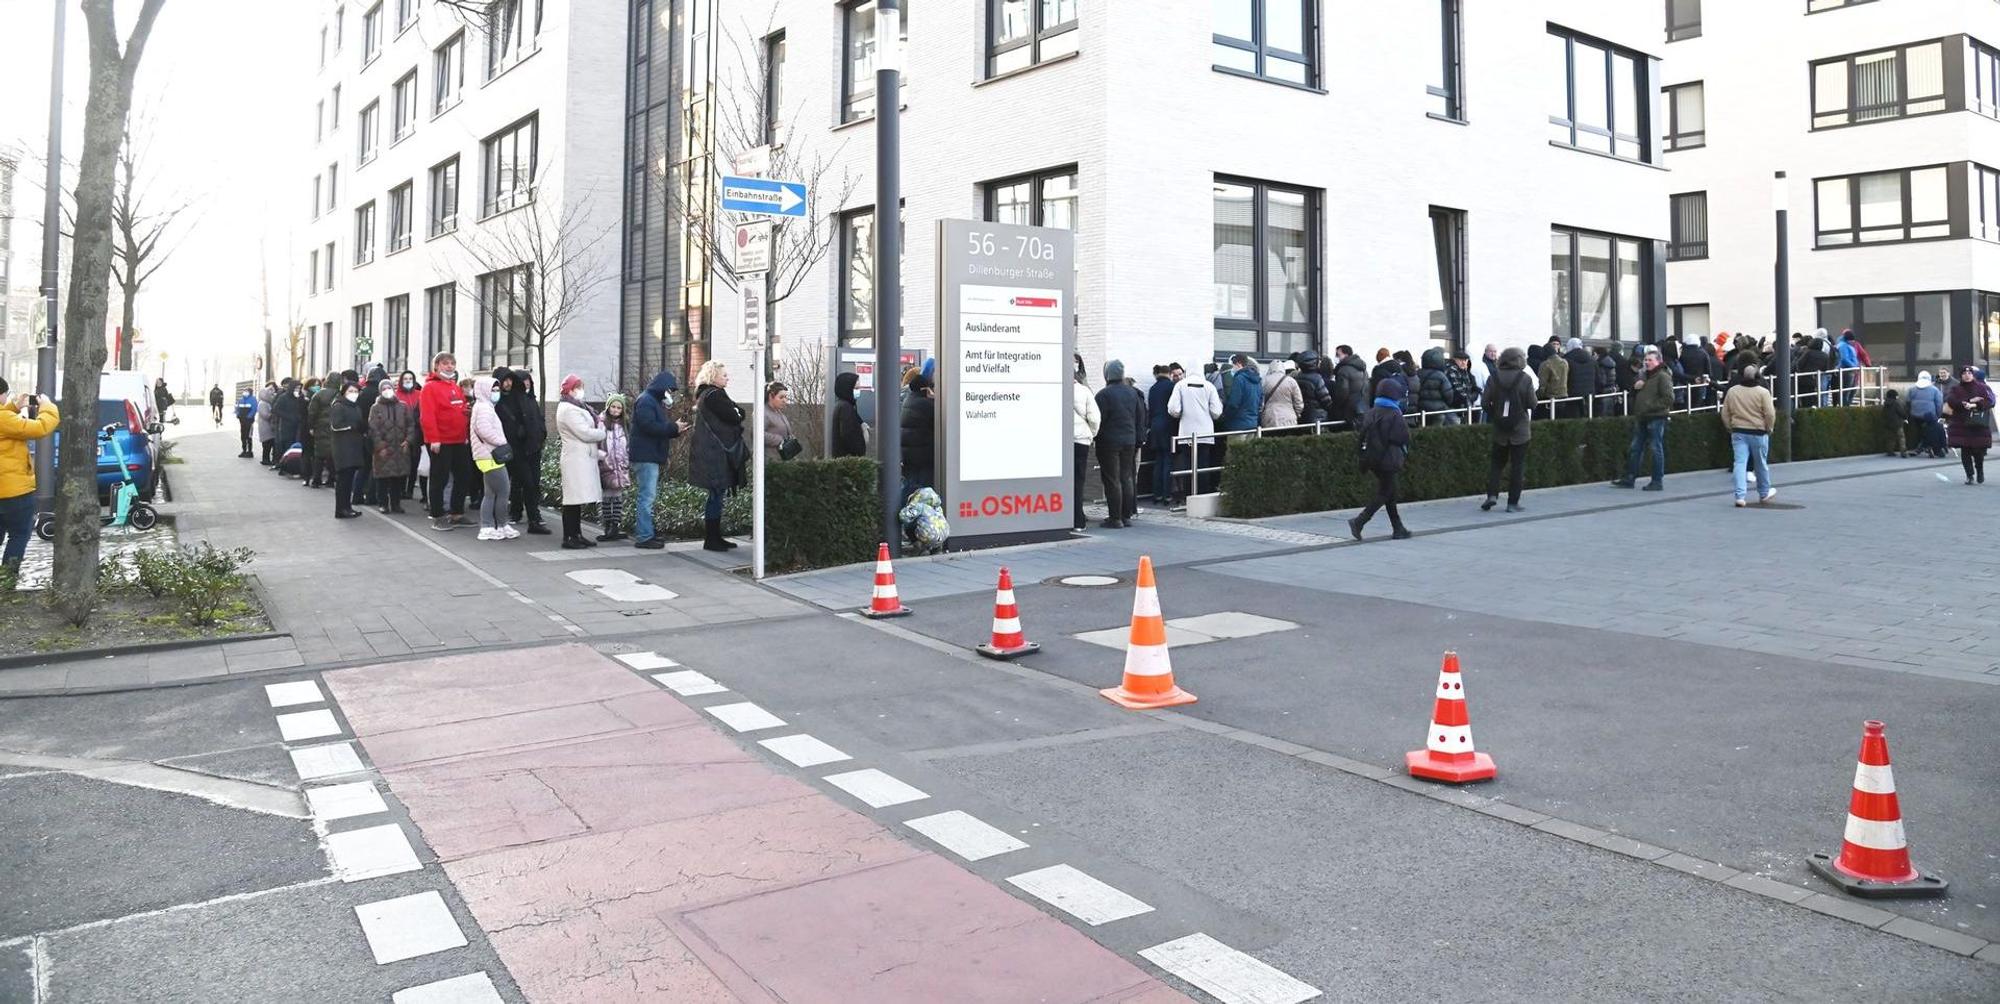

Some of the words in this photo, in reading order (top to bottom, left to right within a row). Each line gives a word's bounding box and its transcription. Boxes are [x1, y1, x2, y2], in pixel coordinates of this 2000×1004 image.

[726, 189, 782, 202] Einbahnstraße
[968, 231, 995, 256] 56
[1015, 235, 1054, 260] 70a
[968, 264, 1024, 279] Dillenburger
[1026, 267, 1055, 280] Straße
[965, 322, 1021, 333] Ausländeramt
[965, 350, 982, 360] Amt
[984, 349, 996, 360] für
[997, 351, 1042, 362] Integration
[965, 363, 981, 373] und
[983, 363, 1010, 373] Vielfalt
[965, 392, 1021, 403] Bürgerdienste
[965, 410, 997, 419] Wahlamt
[981, 492, 1063, 516] OSMAB
